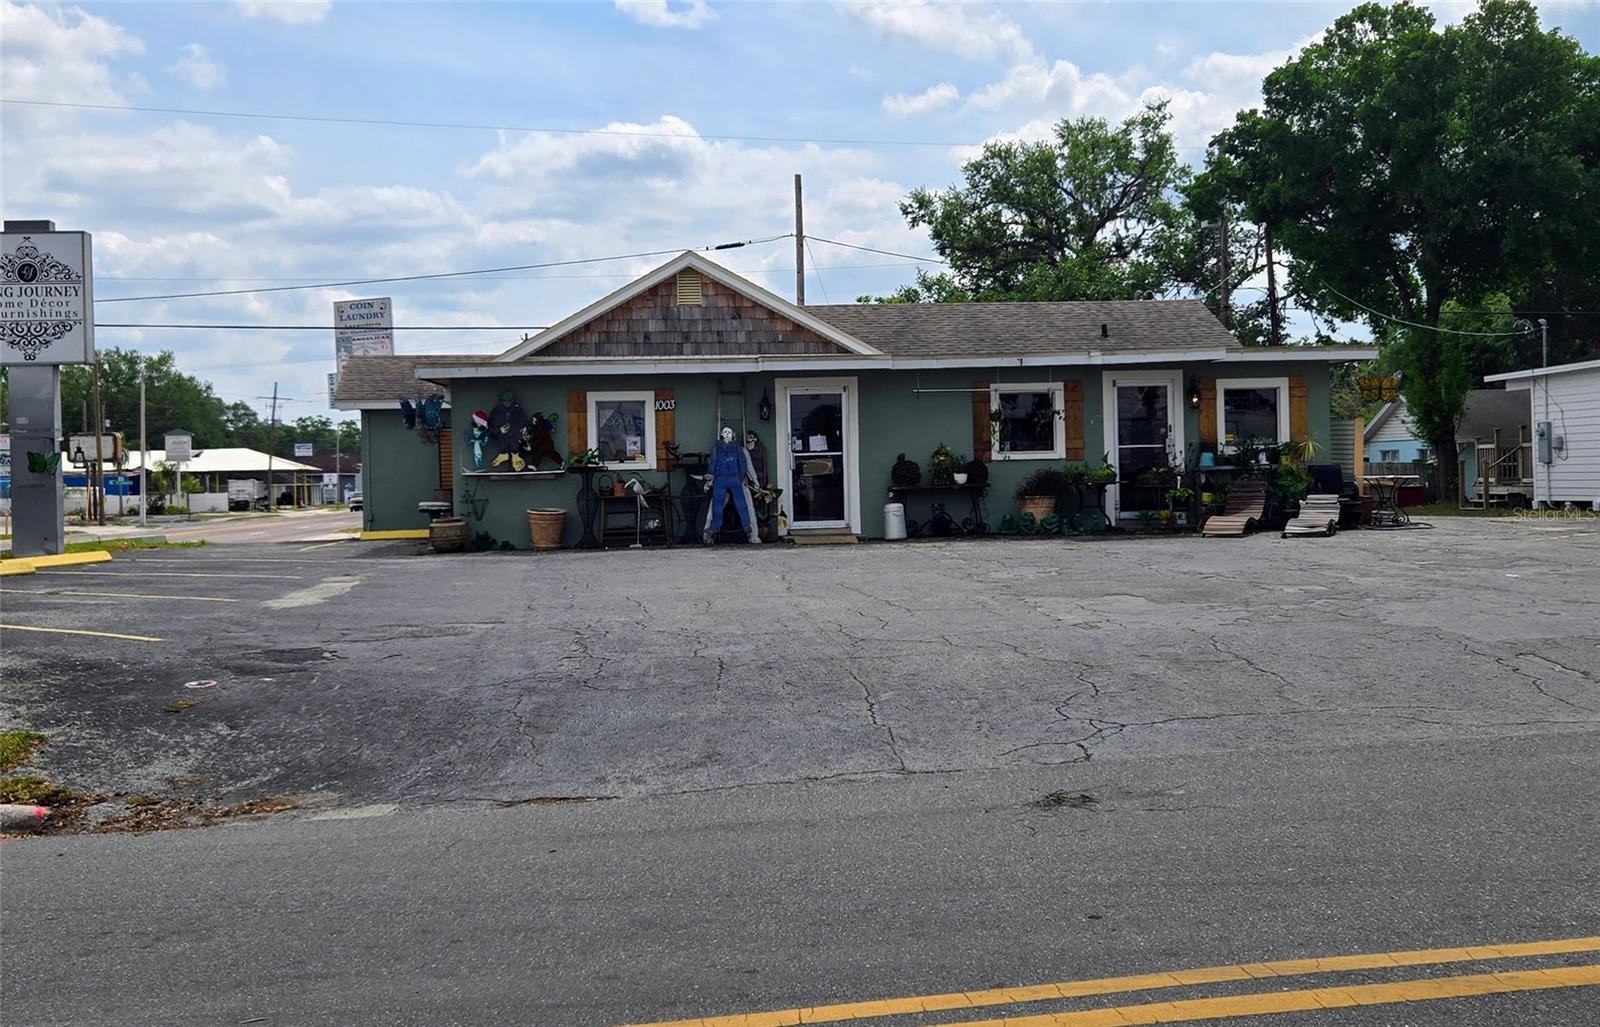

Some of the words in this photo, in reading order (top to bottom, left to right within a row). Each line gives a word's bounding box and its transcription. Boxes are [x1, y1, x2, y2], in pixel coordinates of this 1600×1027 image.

[17, 286, 81, 298] JOURNEY
[30, 298, 71, 308] Décor
[349, 302, 374, 311] COIN
[339, 311, 386, 322] LAUNDRY
[655, 399, 675, 410] 1003
[606, 416, 633, 426] open
